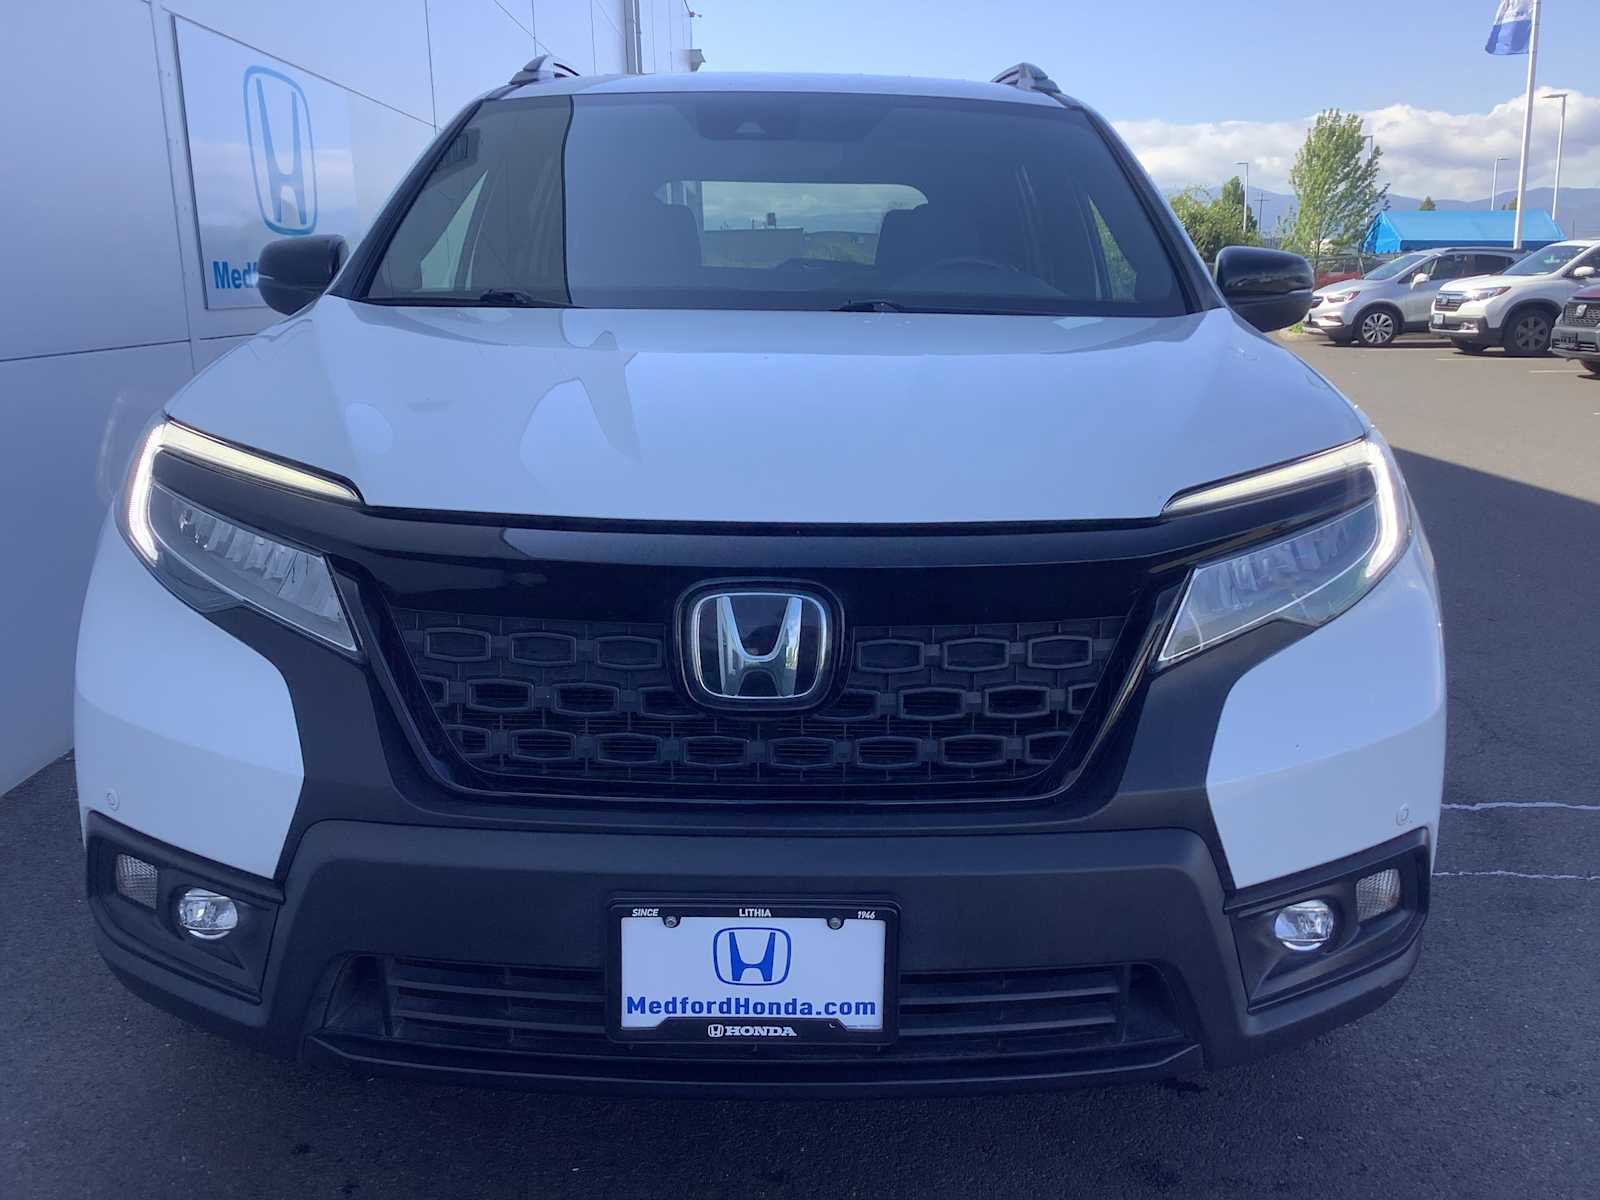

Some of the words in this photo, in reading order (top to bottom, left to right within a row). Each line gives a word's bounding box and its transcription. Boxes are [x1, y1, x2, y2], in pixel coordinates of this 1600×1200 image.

[213, 261, 258, 288] Med
[632, 908, 659, 917] SINCE
[739, 908, 772, 917] LITHIA
[857, 911, 876, 919] 1946
[627, 996, 876, 1015] MedfordHonda.com
[725, 1025, 797, 1037] HONDA
